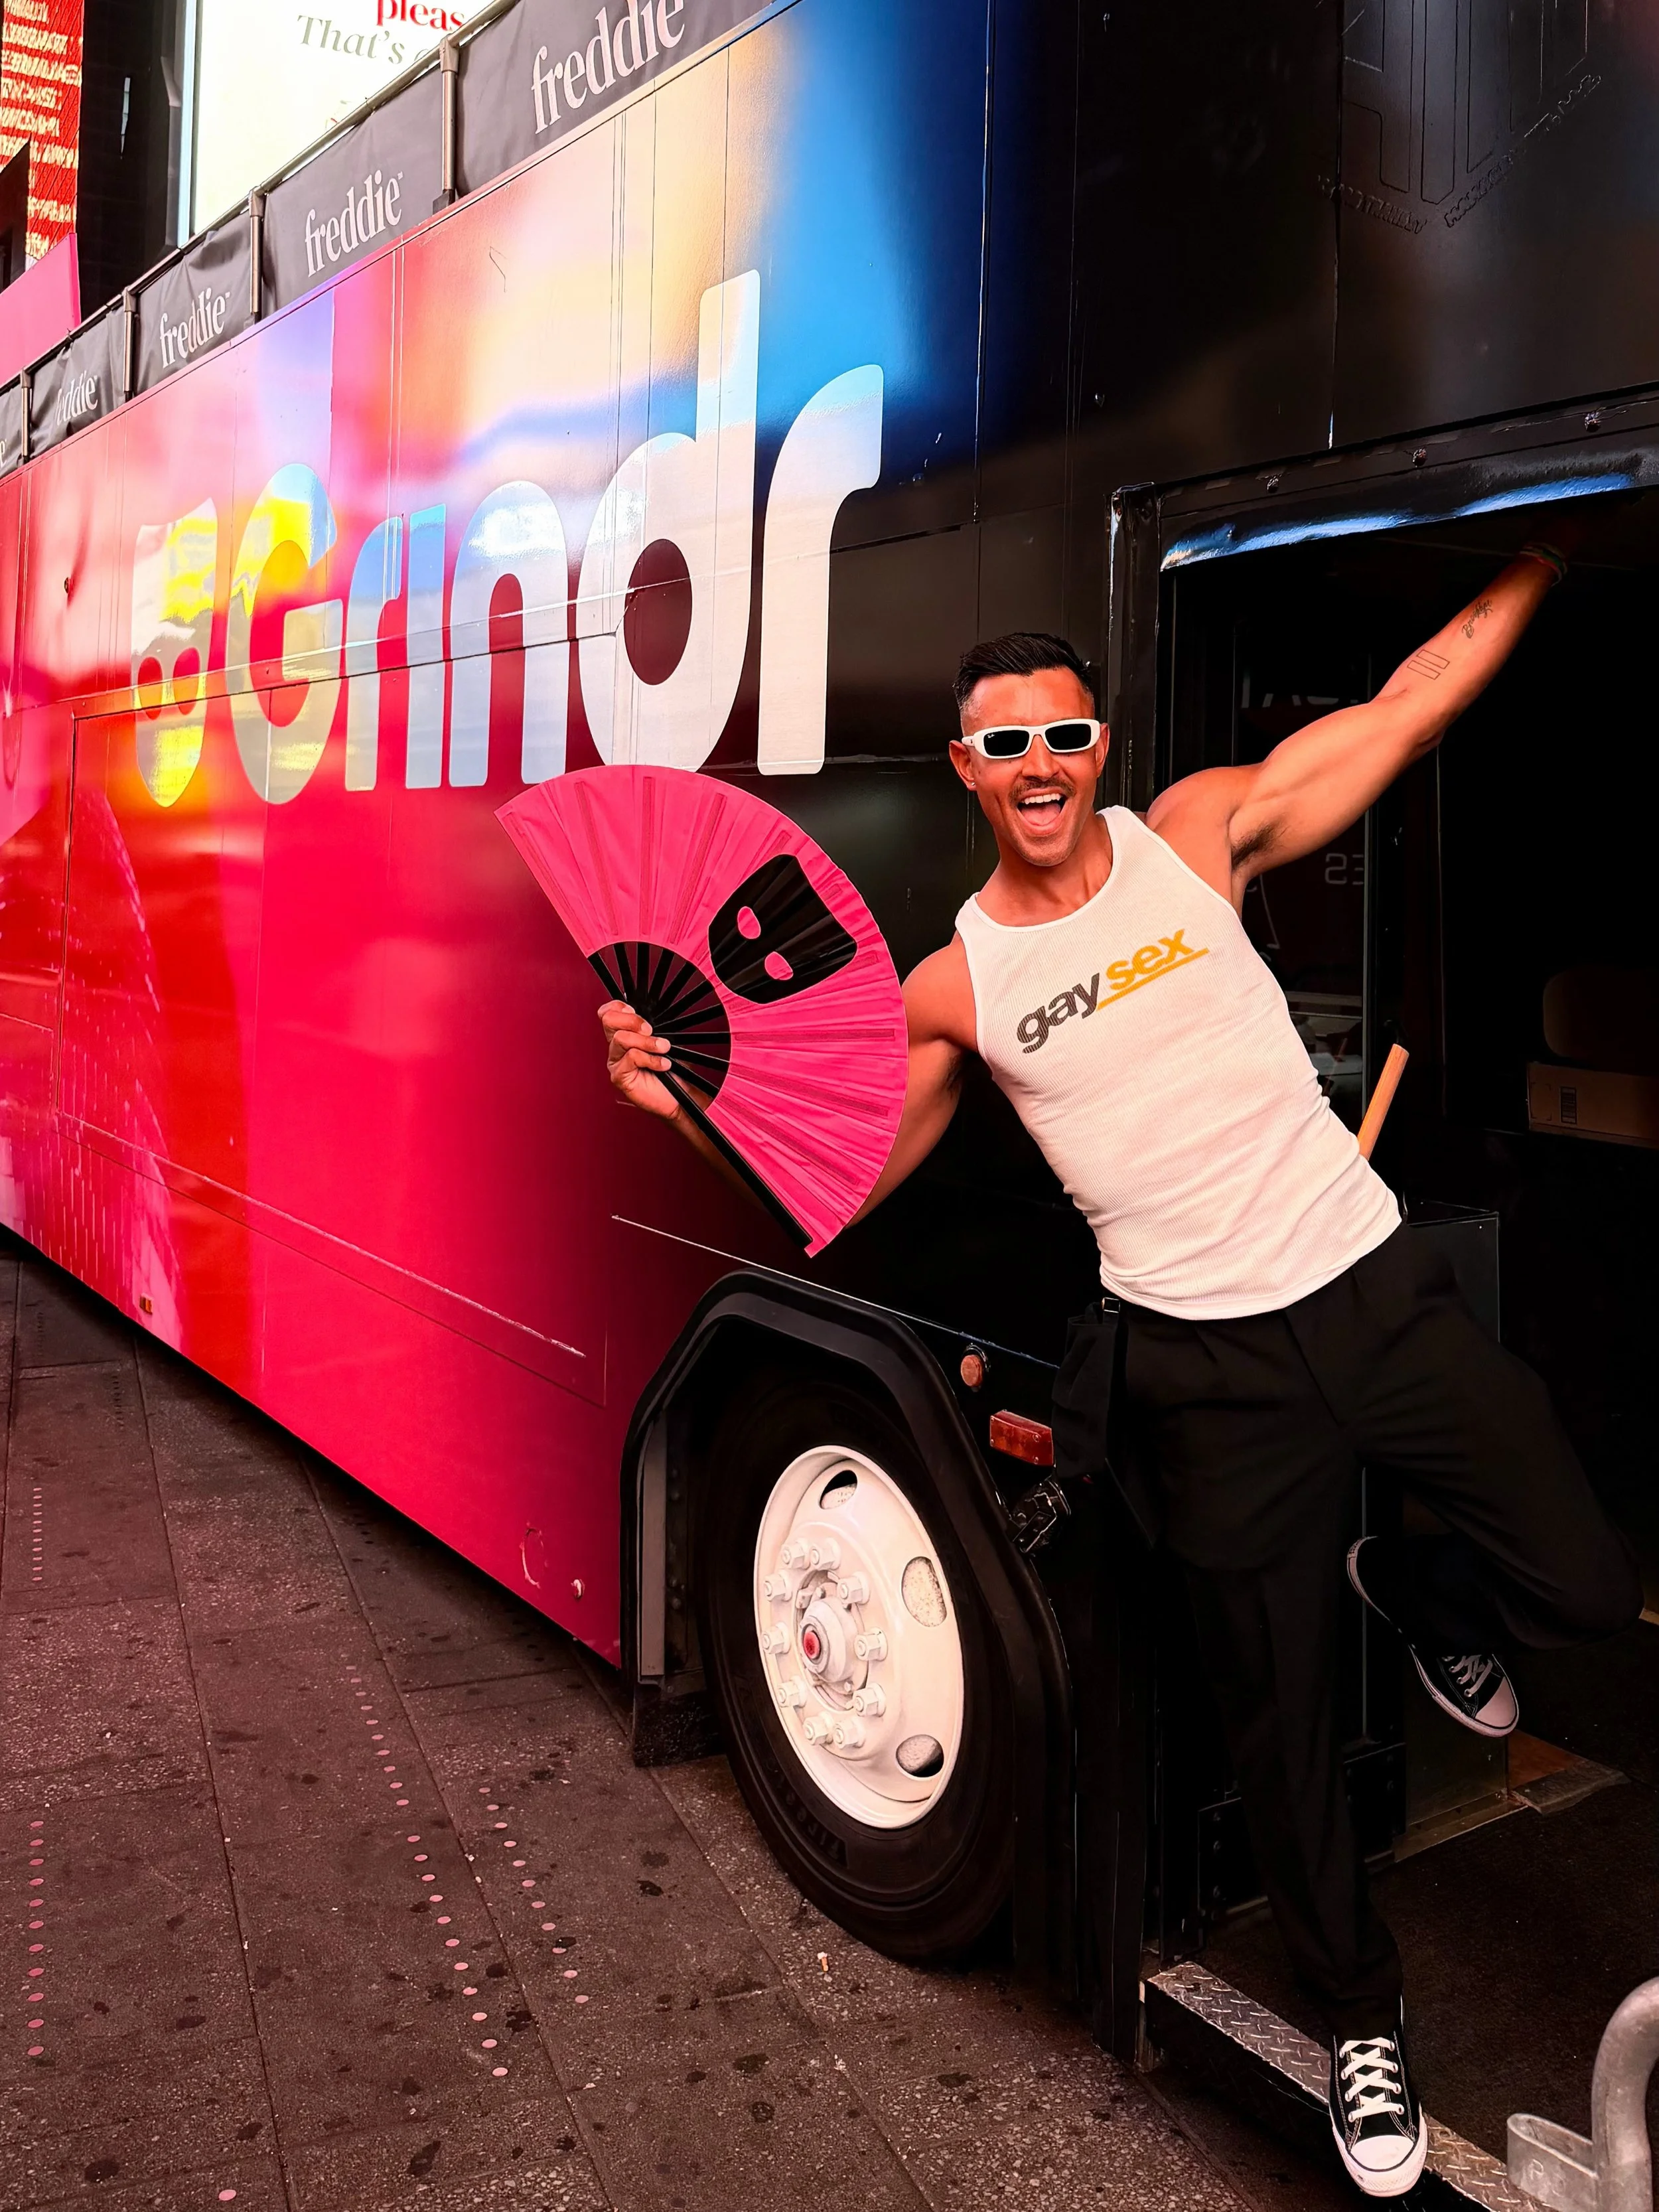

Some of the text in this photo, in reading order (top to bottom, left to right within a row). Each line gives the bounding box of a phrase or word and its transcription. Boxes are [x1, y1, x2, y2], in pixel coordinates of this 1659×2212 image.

[297, 15, 406, 64] That's
[531, 0, 685, 135] freddie
[304, 169, 403, 277] freddie
[159, 287, 230, 369] freddie
[225, 269, 885, 805] Grindr
[1016, 928, 1194, 1055] gay sex
